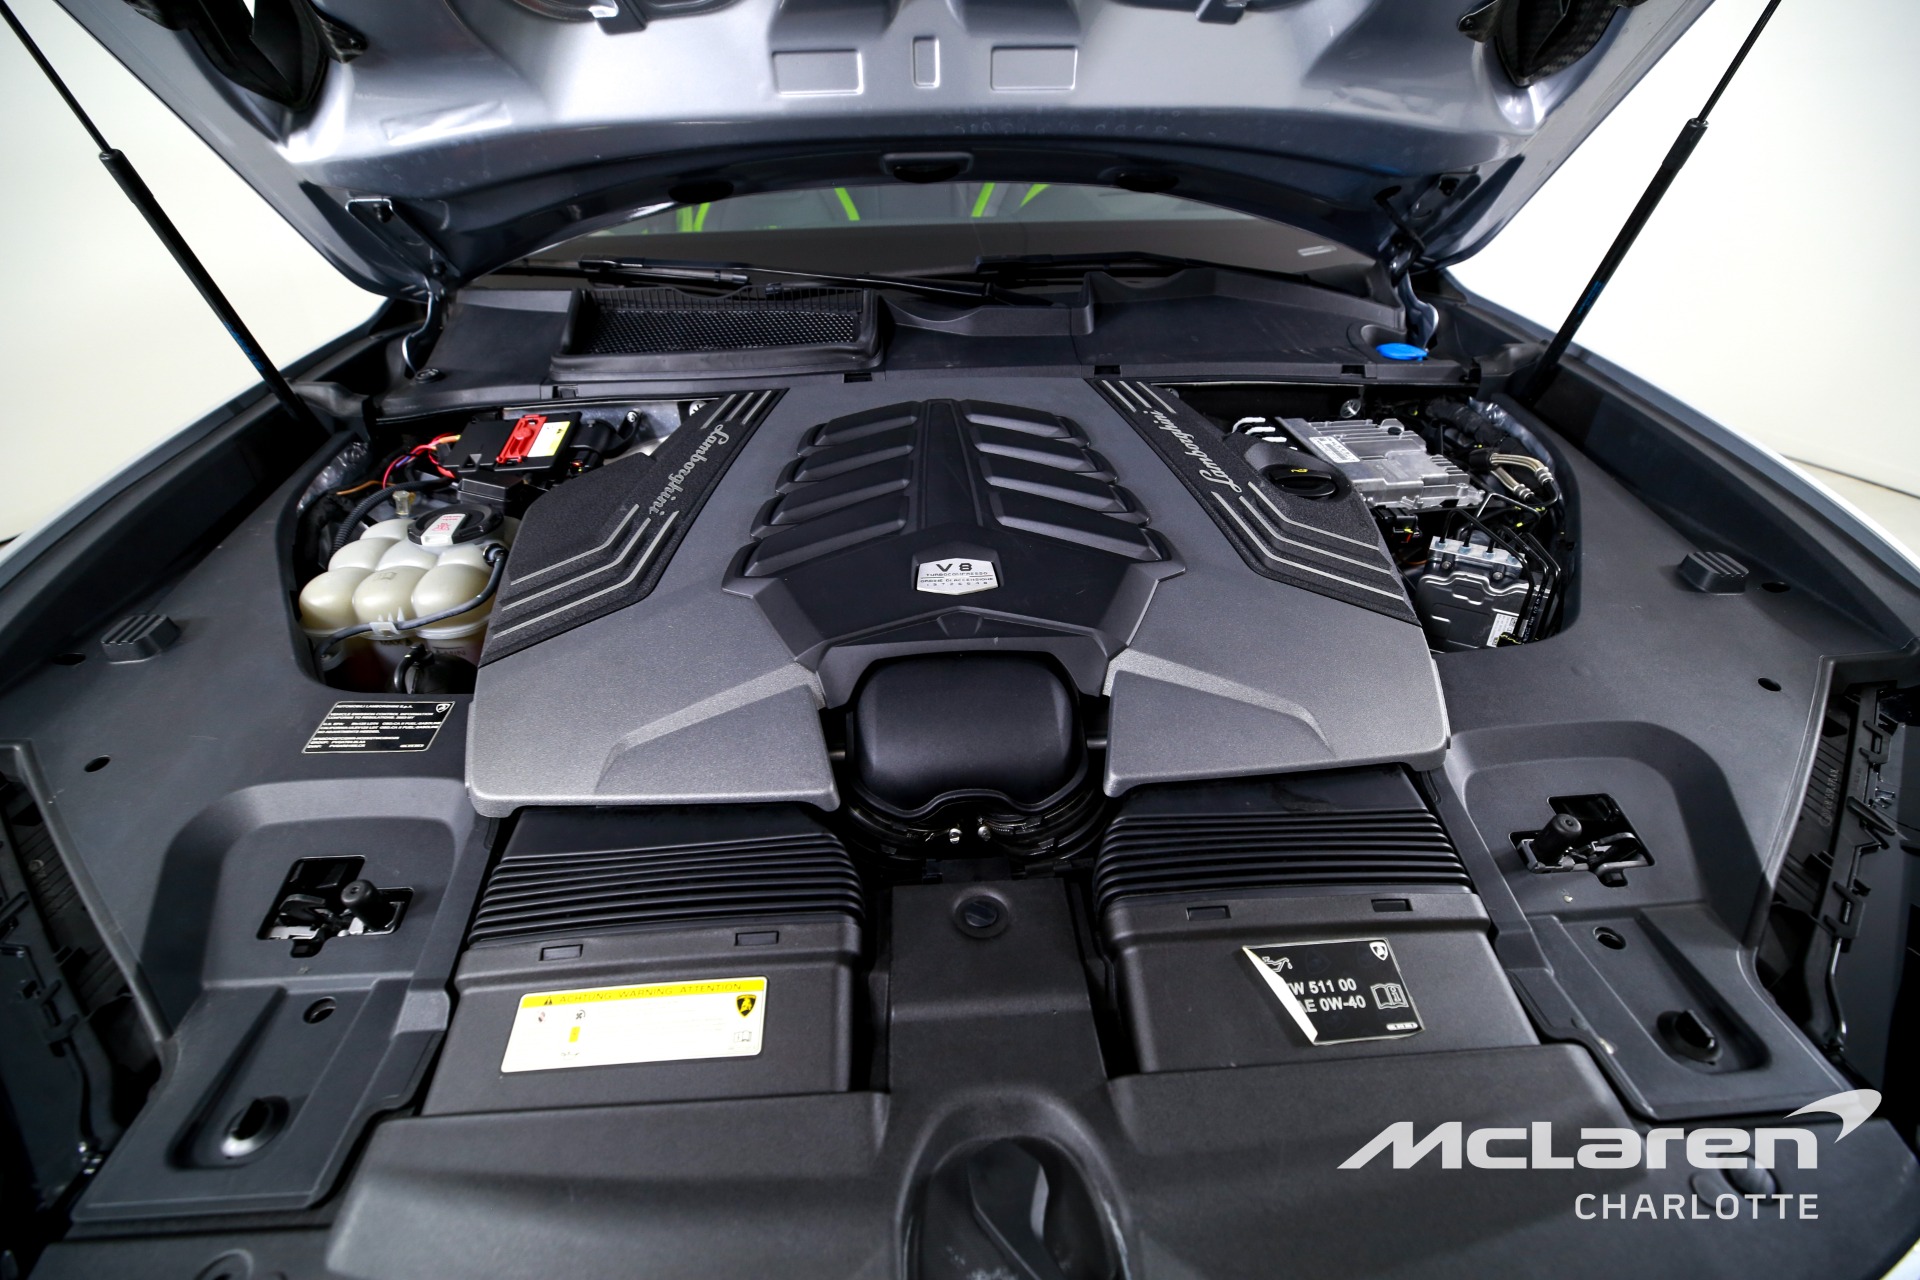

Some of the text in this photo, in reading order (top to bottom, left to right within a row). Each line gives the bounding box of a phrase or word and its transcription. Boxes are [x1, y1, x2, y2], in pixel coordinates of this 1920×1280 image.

[1143, 409, 1243, 493] Lamborghini
[649, 424, 730, 516] Lamborghini
[559, 982, 742, 1003] ACHTUNG WARNING ATTENTION
[1286, 977, 1357, 996] W 511 00
[1319, 994, 1367, 1012] 0W-40
